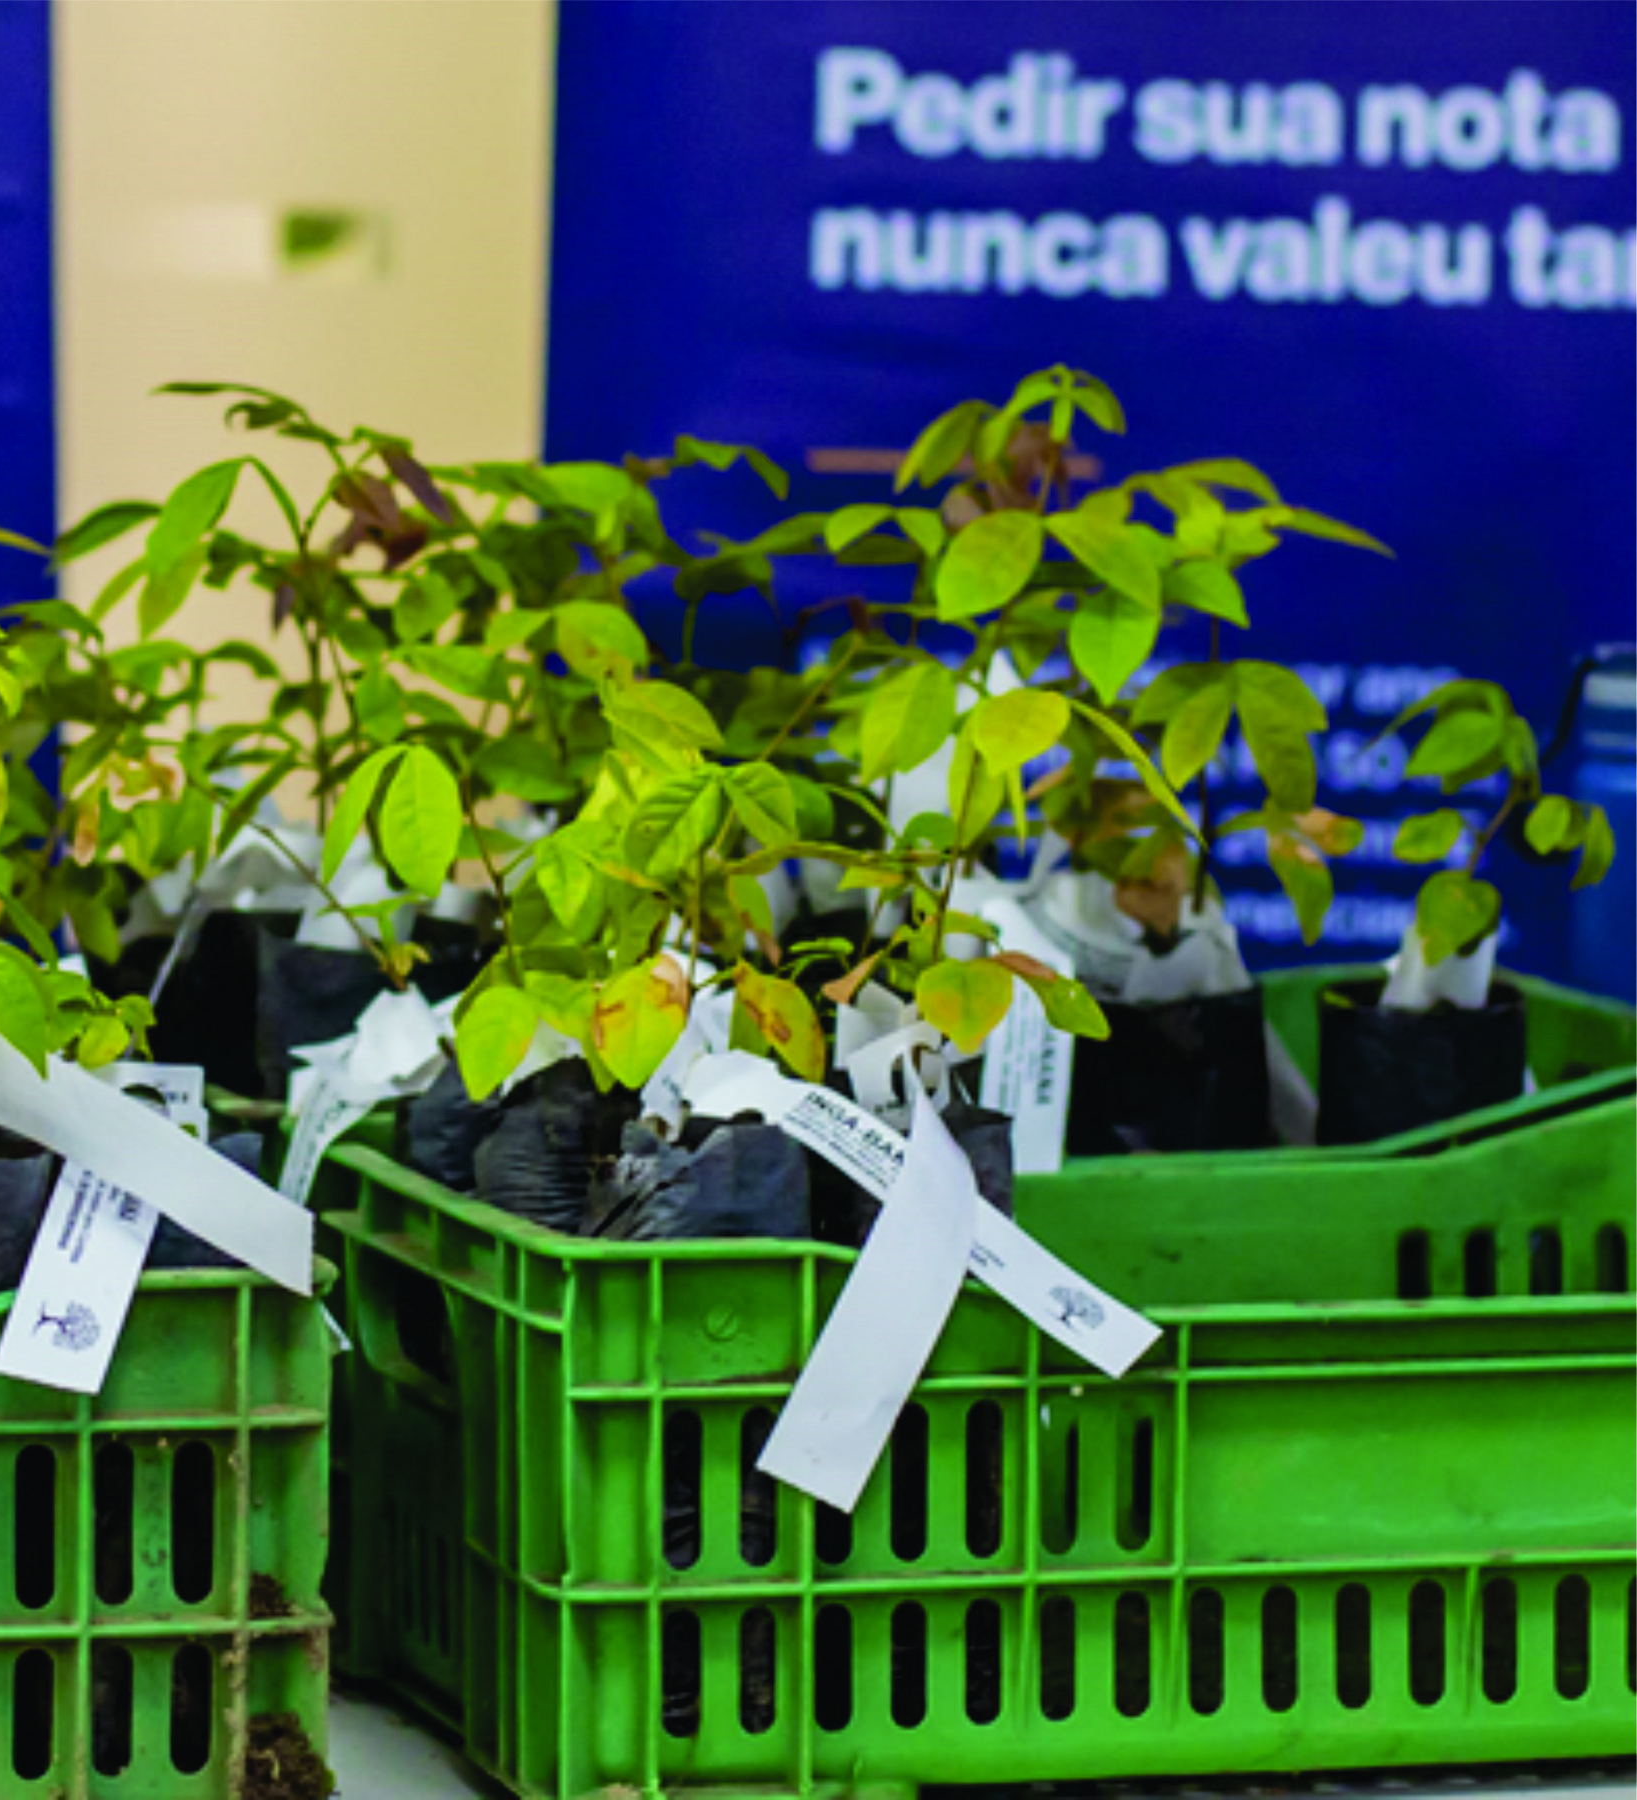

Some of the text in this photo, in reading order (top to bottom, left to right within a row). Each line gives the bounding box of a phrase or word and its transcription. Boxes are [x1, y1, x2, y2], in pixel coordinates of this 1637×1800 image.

[815, 45, 1621, 172] Pedir sua nota
[810, 195, 1637, 310] nunca valeu ta
